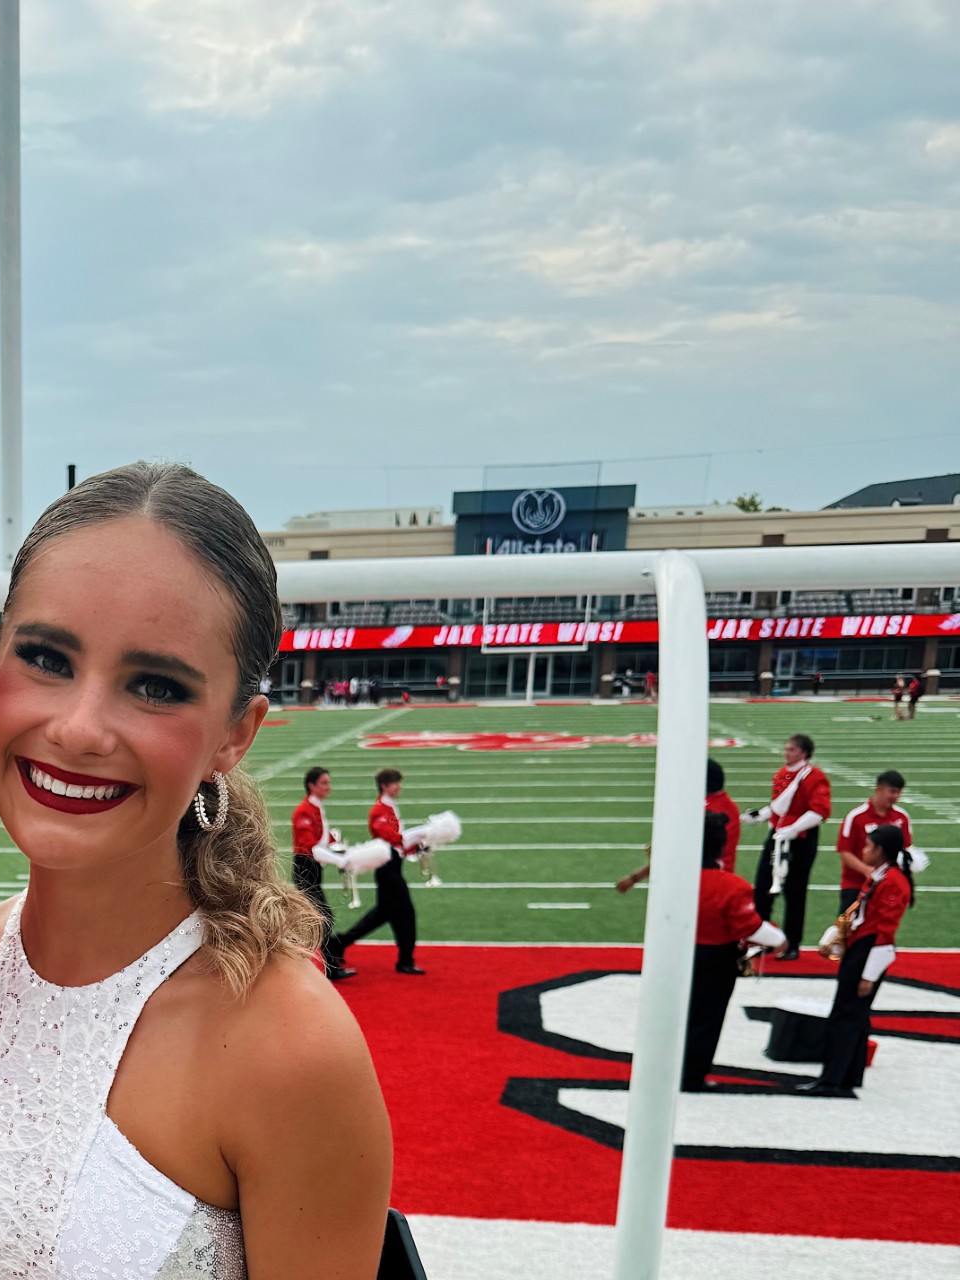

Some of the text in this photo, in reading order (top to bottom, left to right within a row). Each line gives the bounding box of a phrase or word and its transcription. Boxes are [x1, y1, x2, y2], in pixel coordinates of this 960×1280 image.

[292, 627, 356, 650] WINS!
[433, 621, 625, 646] JAX STATE WINS!
[707, 614, 912, 639] JAX STATE WINS!
